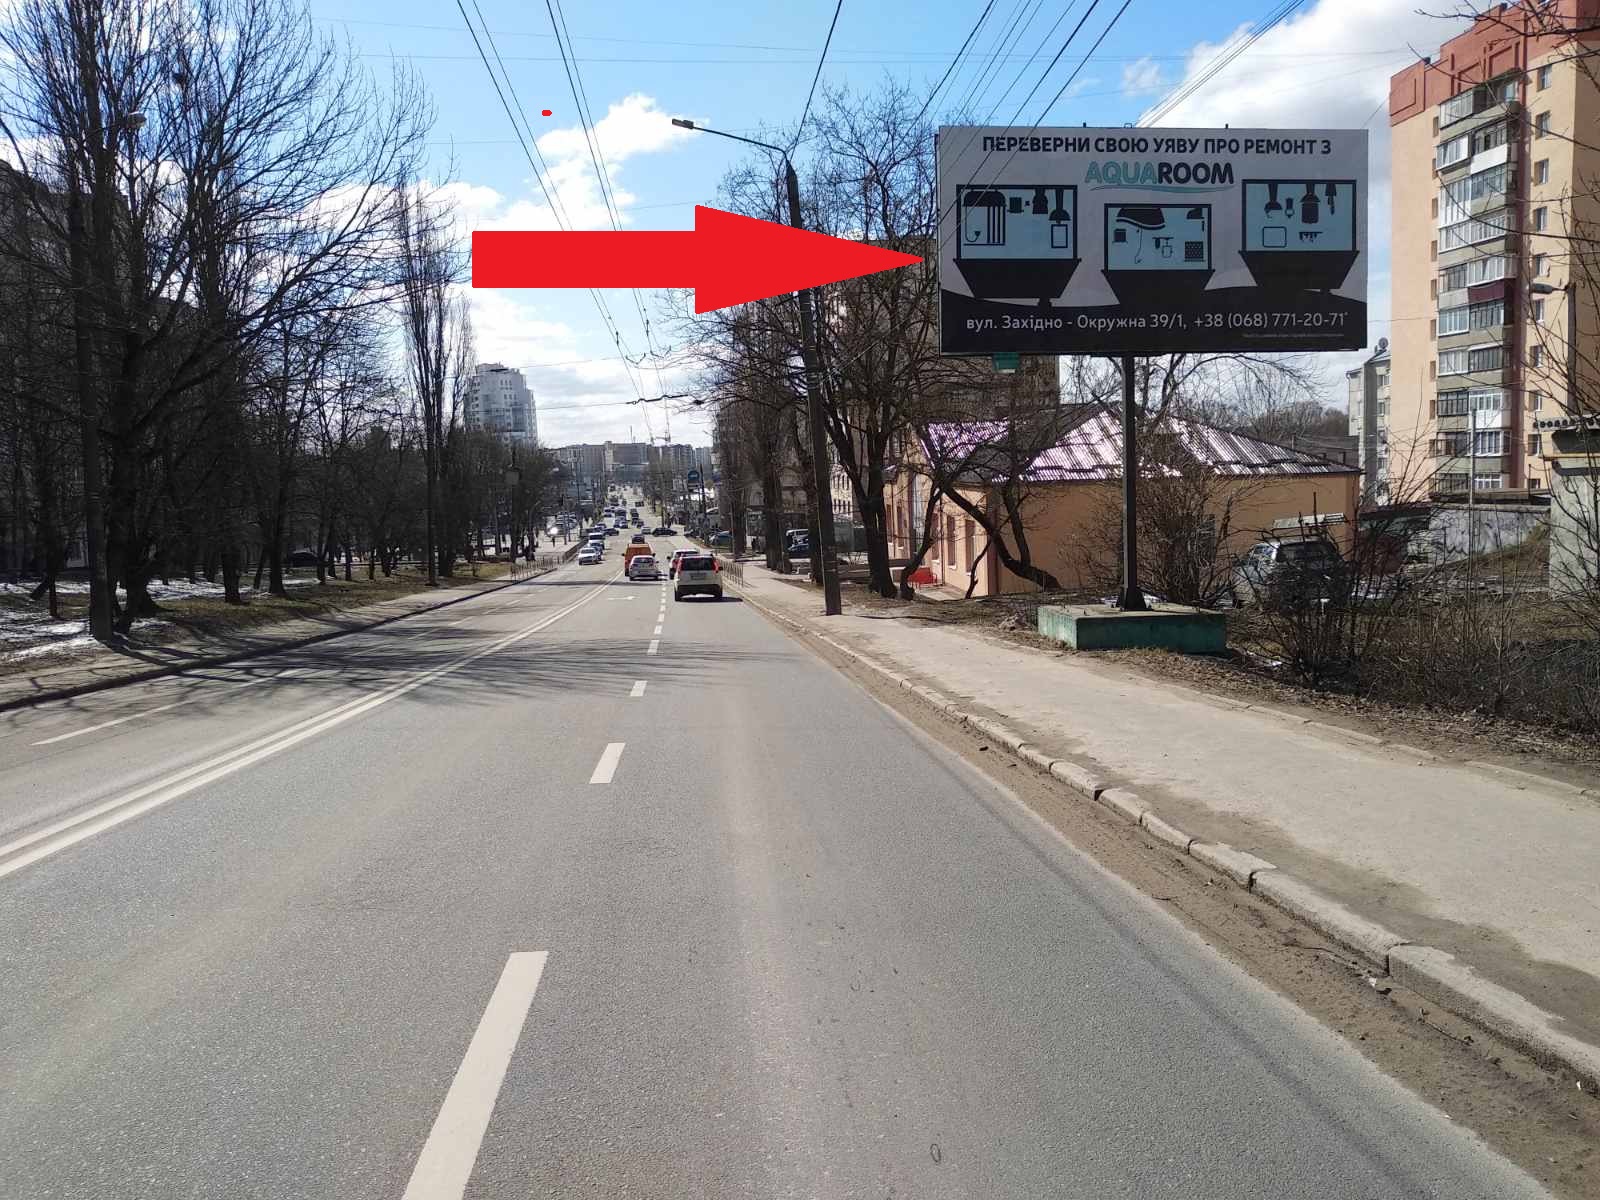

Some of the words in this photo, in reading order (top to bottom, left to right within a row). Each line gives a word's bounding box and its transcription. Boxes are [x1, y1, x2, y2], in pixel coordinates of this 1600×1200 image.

[983, 136, 1090, 152] ПЕРЕВЕРНИ
[1094, 137, 1149, 153] СВОЮ
[1153, 138, 1200, 154] УЯВУ
[1204, 138, 1240, 154] ПРО
[1244, 139, 1317, 155] РЕМОНТ
[1321, 139, 1332, 155] З
[1085, 161, 1235, 185] AQUAROOM
[966, 318, 998, 332] вул.
[1001, 315, 1063, 332] Західно
[1077, 314, 1146, 332] Окружна
[1150, 313, 1187, 330] 39/1,
[1194, 313, 1224, 328] +38
[1228, 312, 1268, 330] (068)
